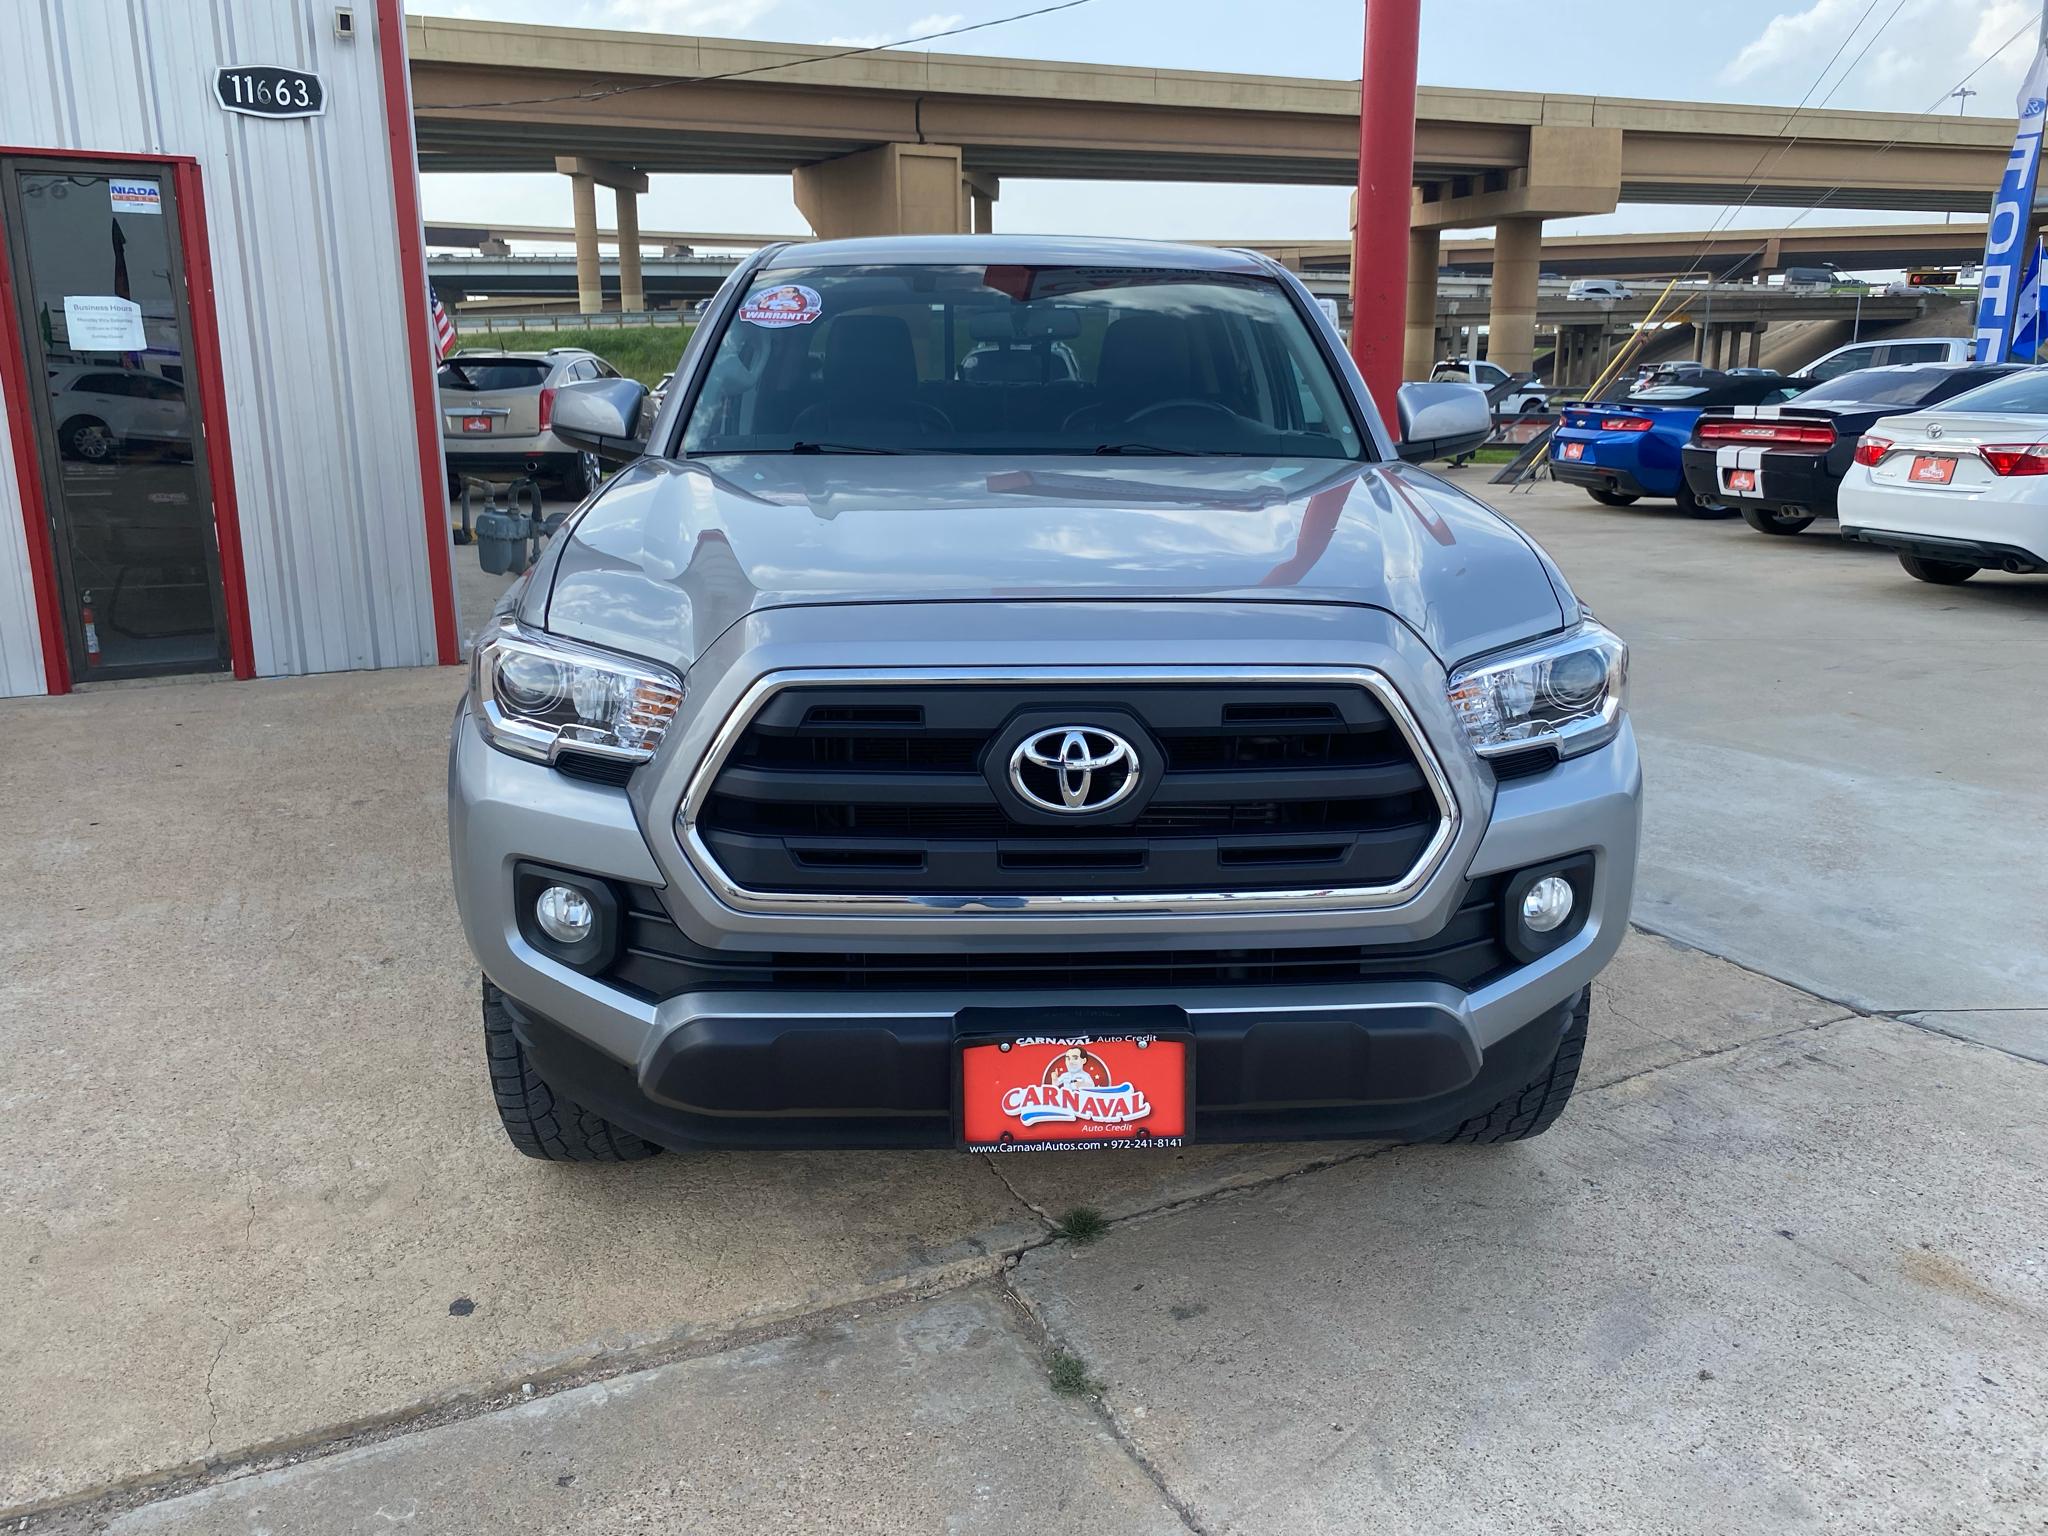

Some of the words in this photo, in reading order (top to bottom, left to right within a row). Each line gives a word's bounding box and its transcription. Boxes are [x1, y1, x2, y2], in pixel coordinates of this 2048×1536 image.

[231, 75, 309, 107] 11663
[111, 186, 158, 196] NIADA
[73, 303, 109, 312] Business
[110, 304, 133, 312] Hours
[746, 311, 811, 321] WARRANTY
[1015, 1035, 1093, 1047] CARNAVAL
[1096, 1035, 1122, 1044] Auto
[1125, 1034, 1157, 1043] Credit
[1003, 1086, 1147, 1118] CARNAVAL
[1081, 1124, 1104, 1132] Auto
[1105, 1123, 1133, 1132] Credit
[969, 1140, 1101, 1154] www.CarnavalAutos.com
[1110, 1138, 1182, 1149] 972-241-8141
